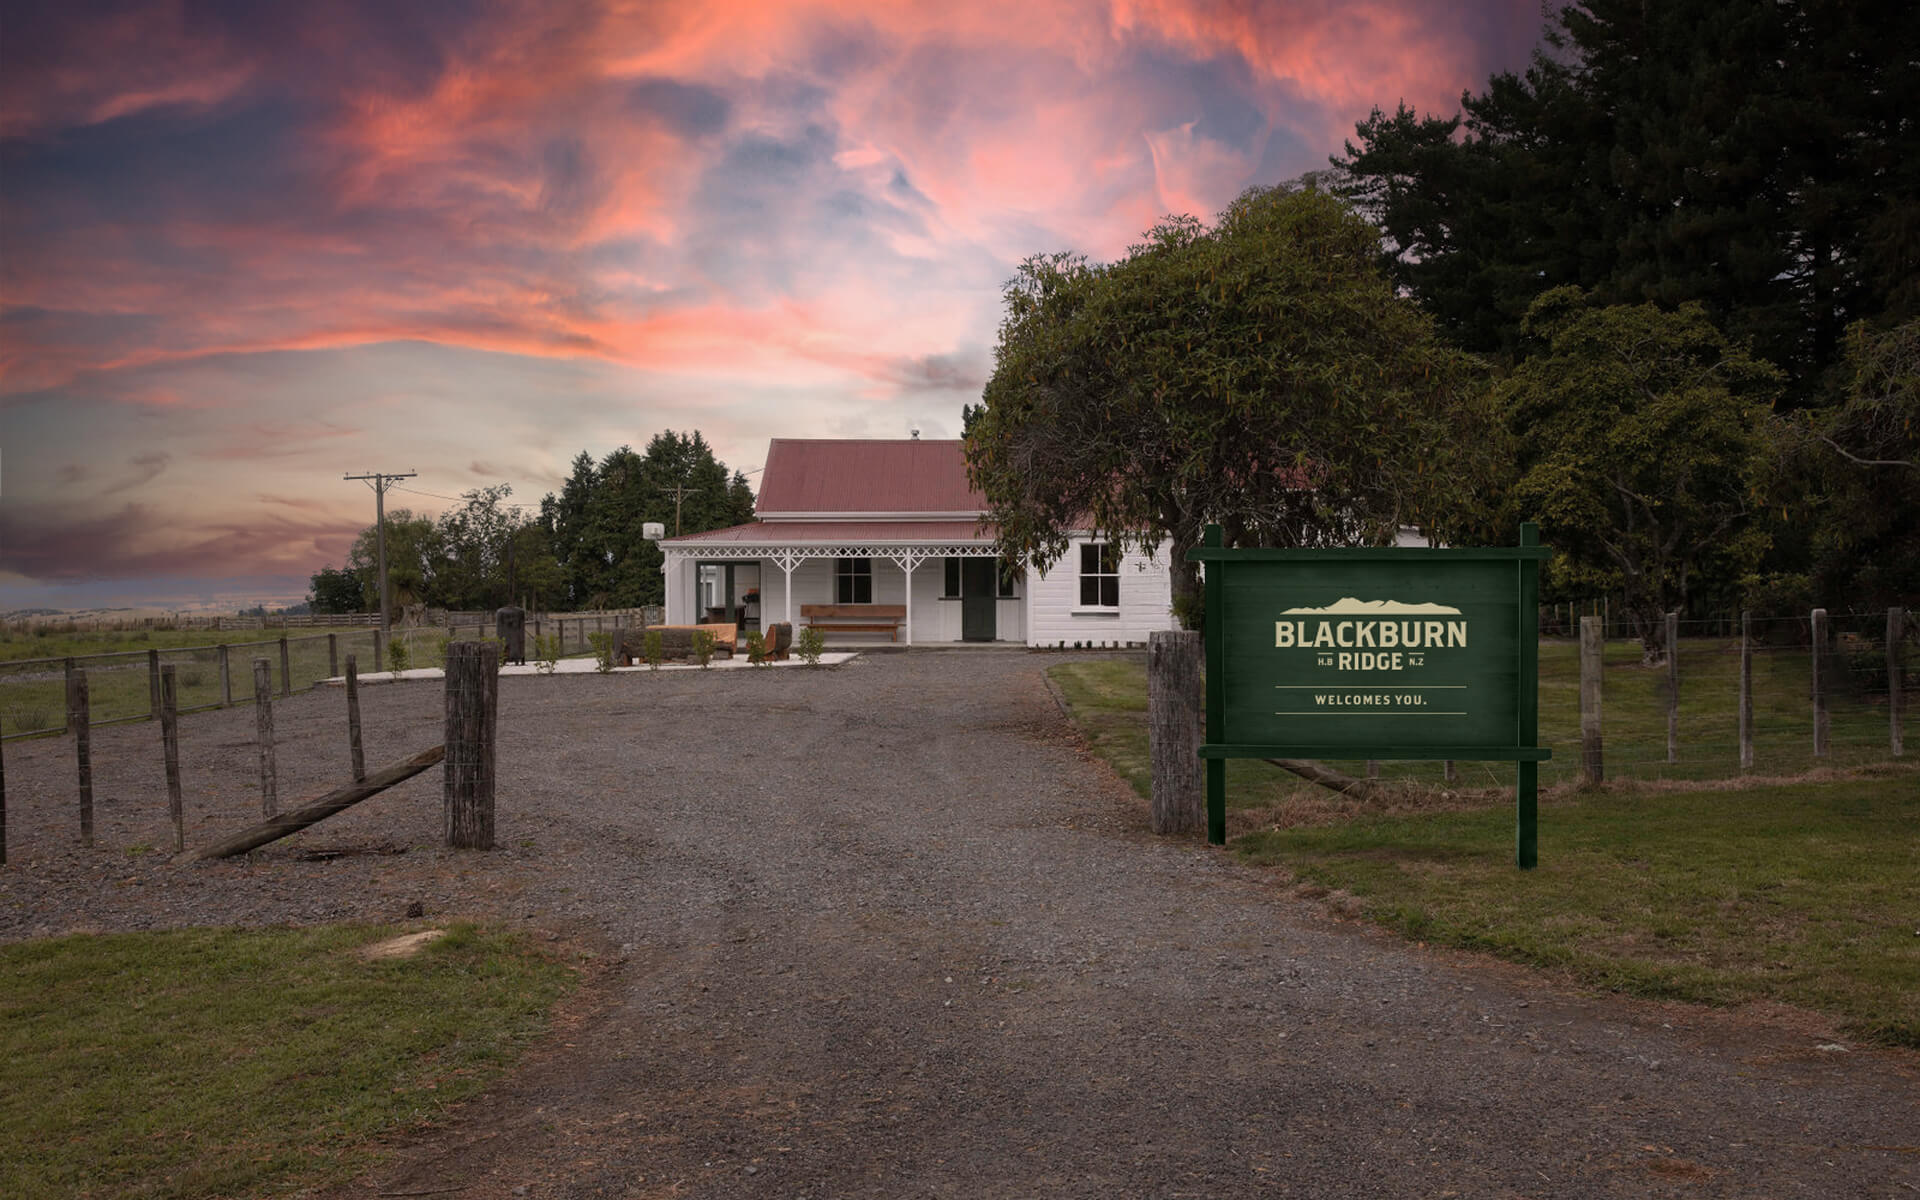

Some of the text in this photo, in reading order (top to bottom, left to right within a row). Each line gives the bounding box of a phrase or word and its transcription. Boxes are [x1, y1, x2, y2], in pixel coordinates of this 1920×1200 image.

[1275, 621, 1467, 647] BLACKBURN
[1338, 652, 1404, 671] RIDGE
[1409, 657, 1424, 666] N.Z
[1314, 694, 1428, 706] WELCOMES YOU.
